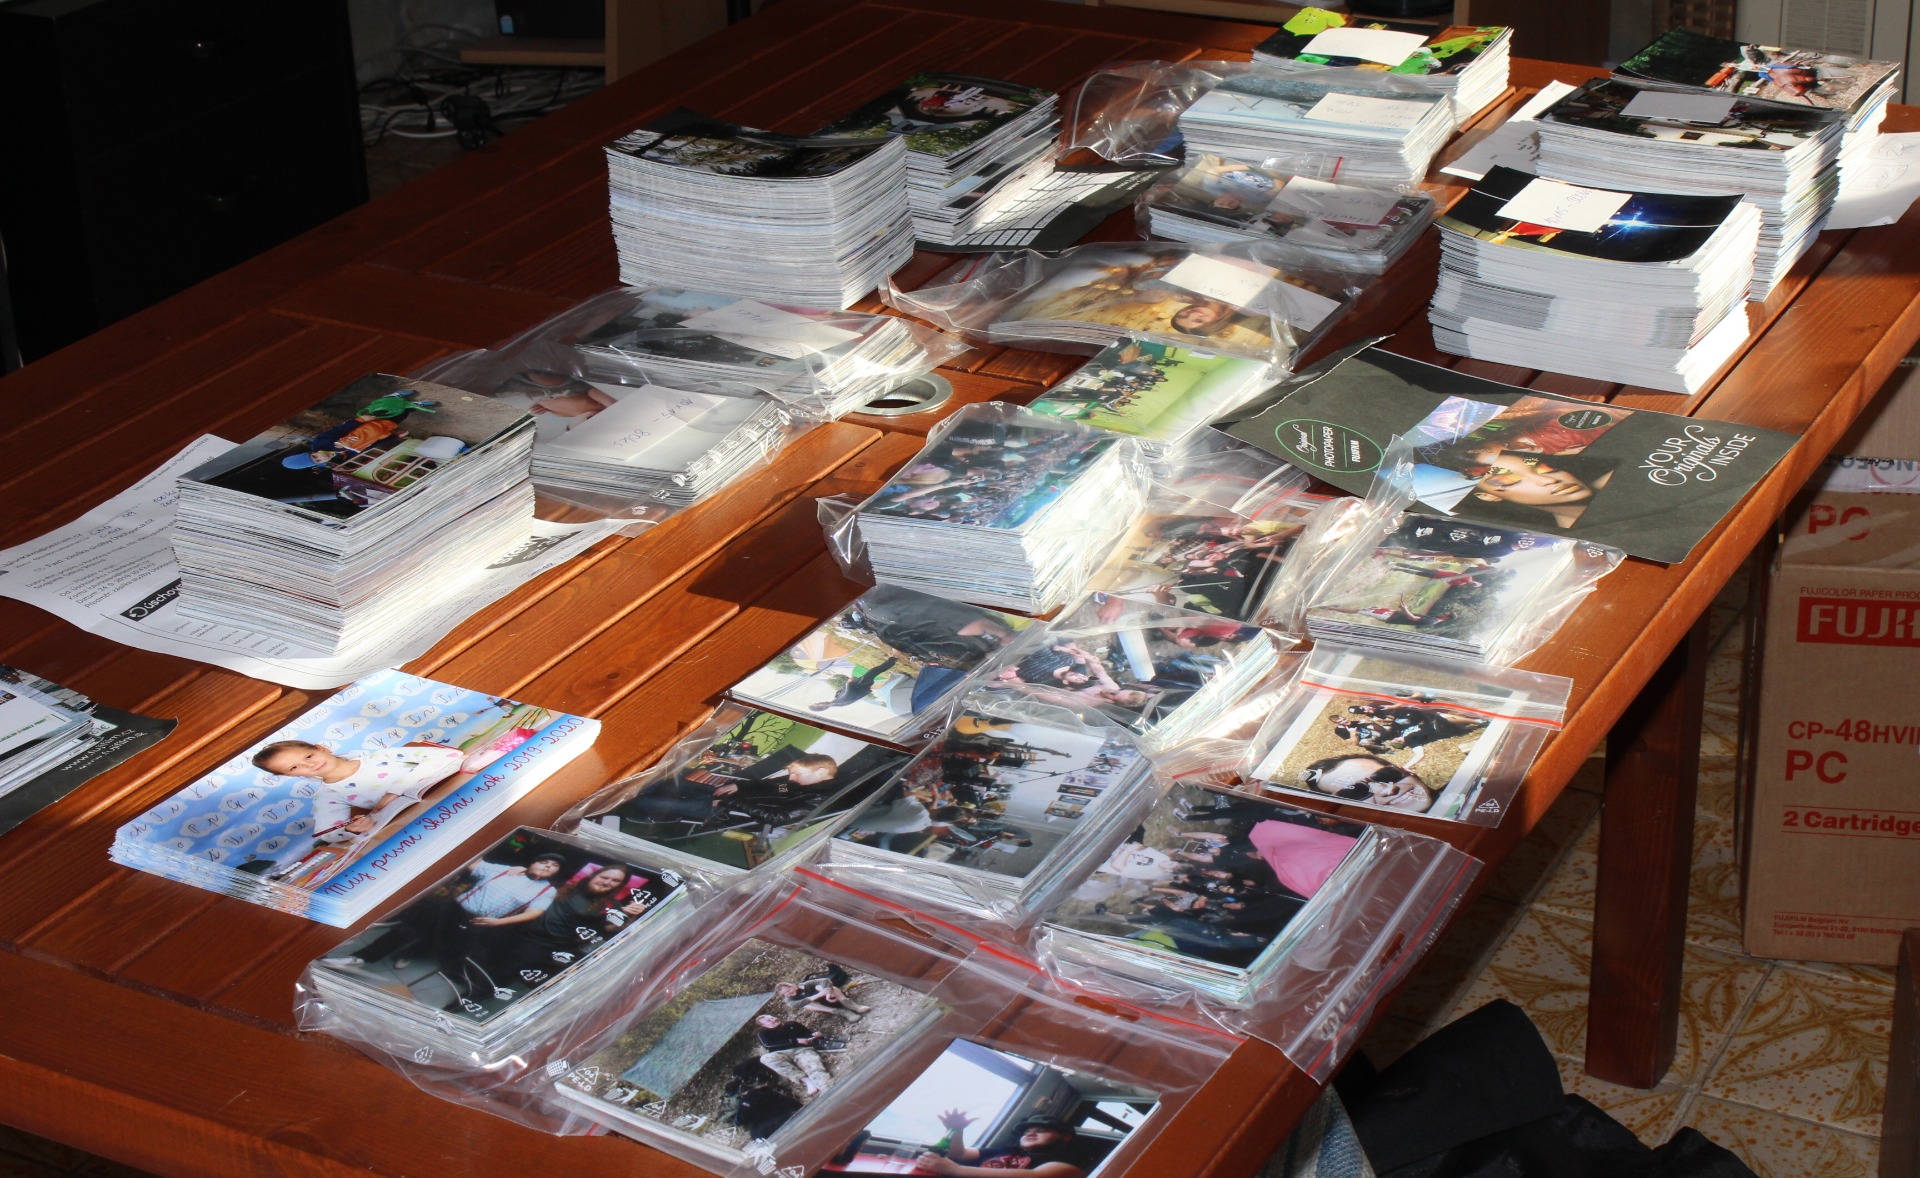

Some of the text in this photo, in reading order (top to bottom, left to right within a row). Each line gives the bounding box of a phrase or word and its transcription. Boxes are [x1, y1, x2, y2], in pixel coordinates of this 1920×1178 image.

[1322, 426, 1336, 468] PHOTOPAPER
[1638, 437, 1693, 469] YOUR
[1648, 425, 1721, 486] Originals
[1708, 433, 1757, 466] INSIDE
[1808, 504, 1871, 541] PC
[1800, 586, 1857, 597] FUJICOLOR
[1859, 588, 1892, 599] PAPER
[1785, 749, 1849, 784] PC
[371, 830, 422, 872] první
[416, 793, 474, 831] školní
[474, 772, 505, 795] rok
[504, 716, 586, 772] 2019-2020
[1782, 810, 1799, 827] 2
[567, 1072, 592, 1091] PE-LD
